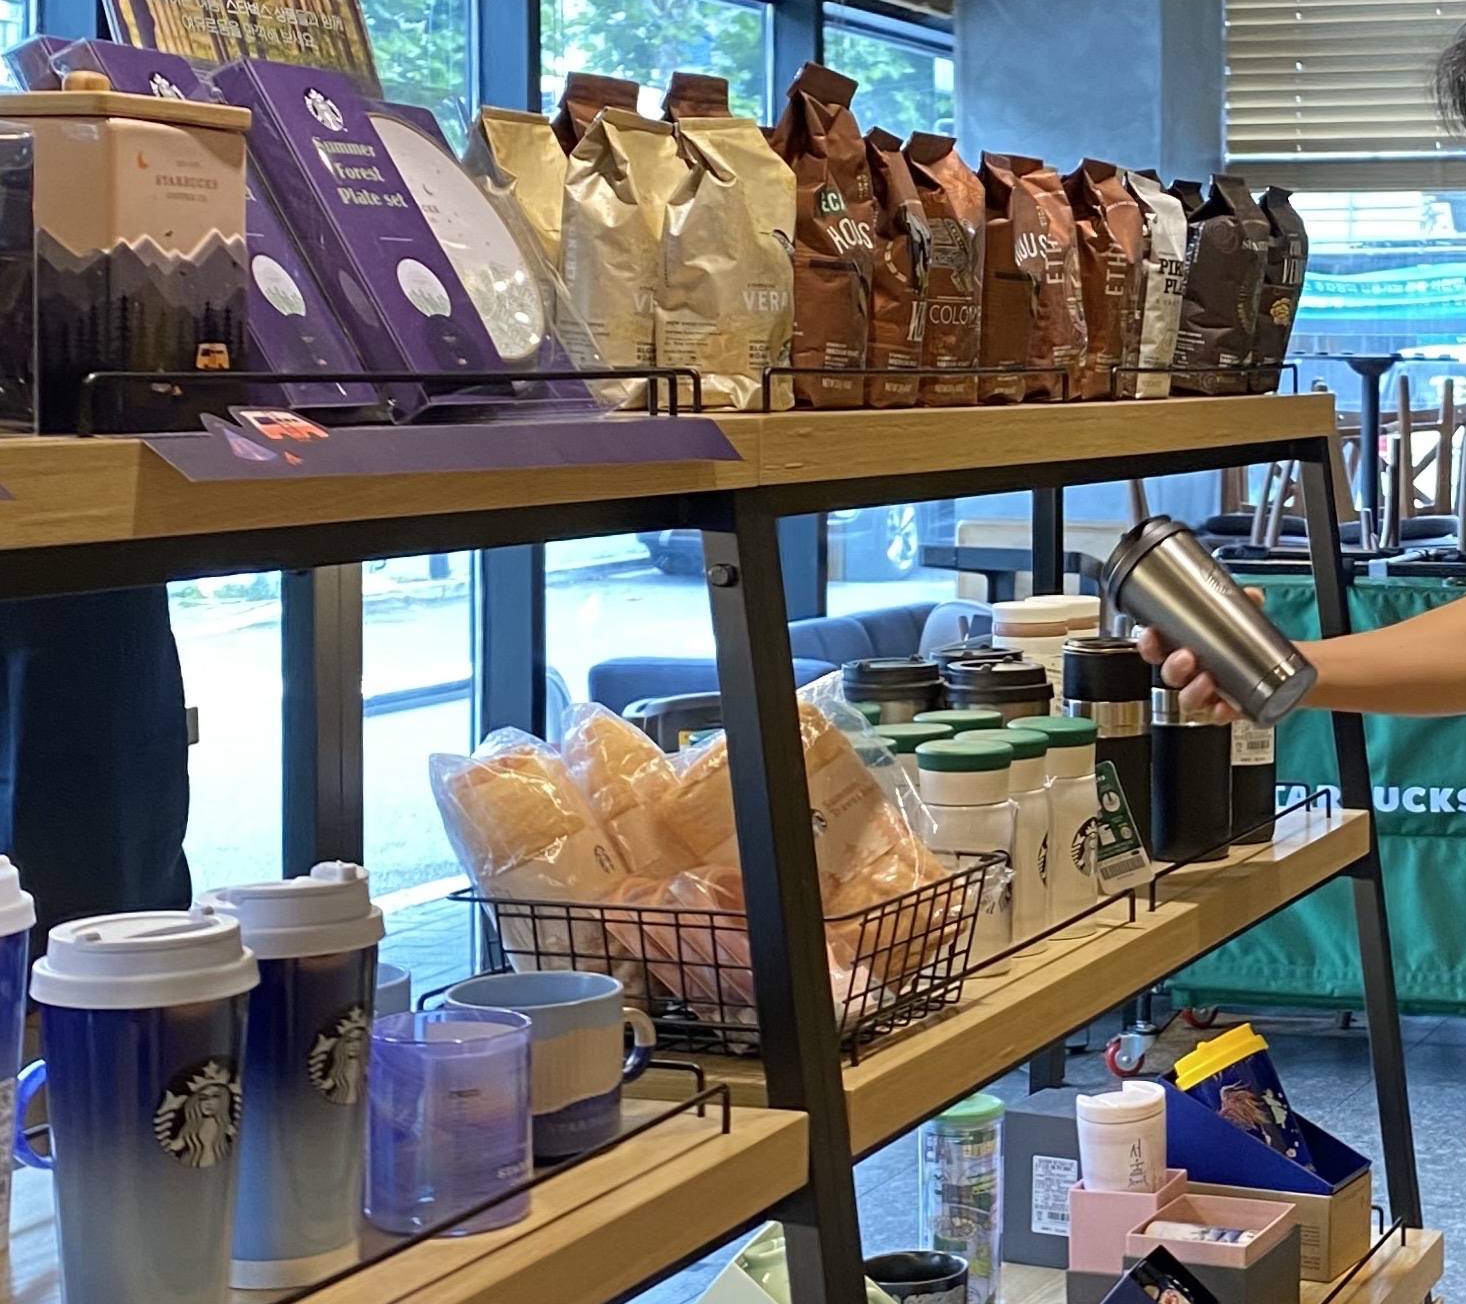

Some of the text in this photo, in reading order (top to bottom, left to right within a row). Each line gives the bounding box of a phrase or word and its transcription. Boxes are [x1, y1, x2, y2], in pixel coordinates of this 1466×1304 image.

[311, 136, 376, 158] Summer
[335, 161, 385, 183] Forest
[336, 186, 409, 209] Plate set
